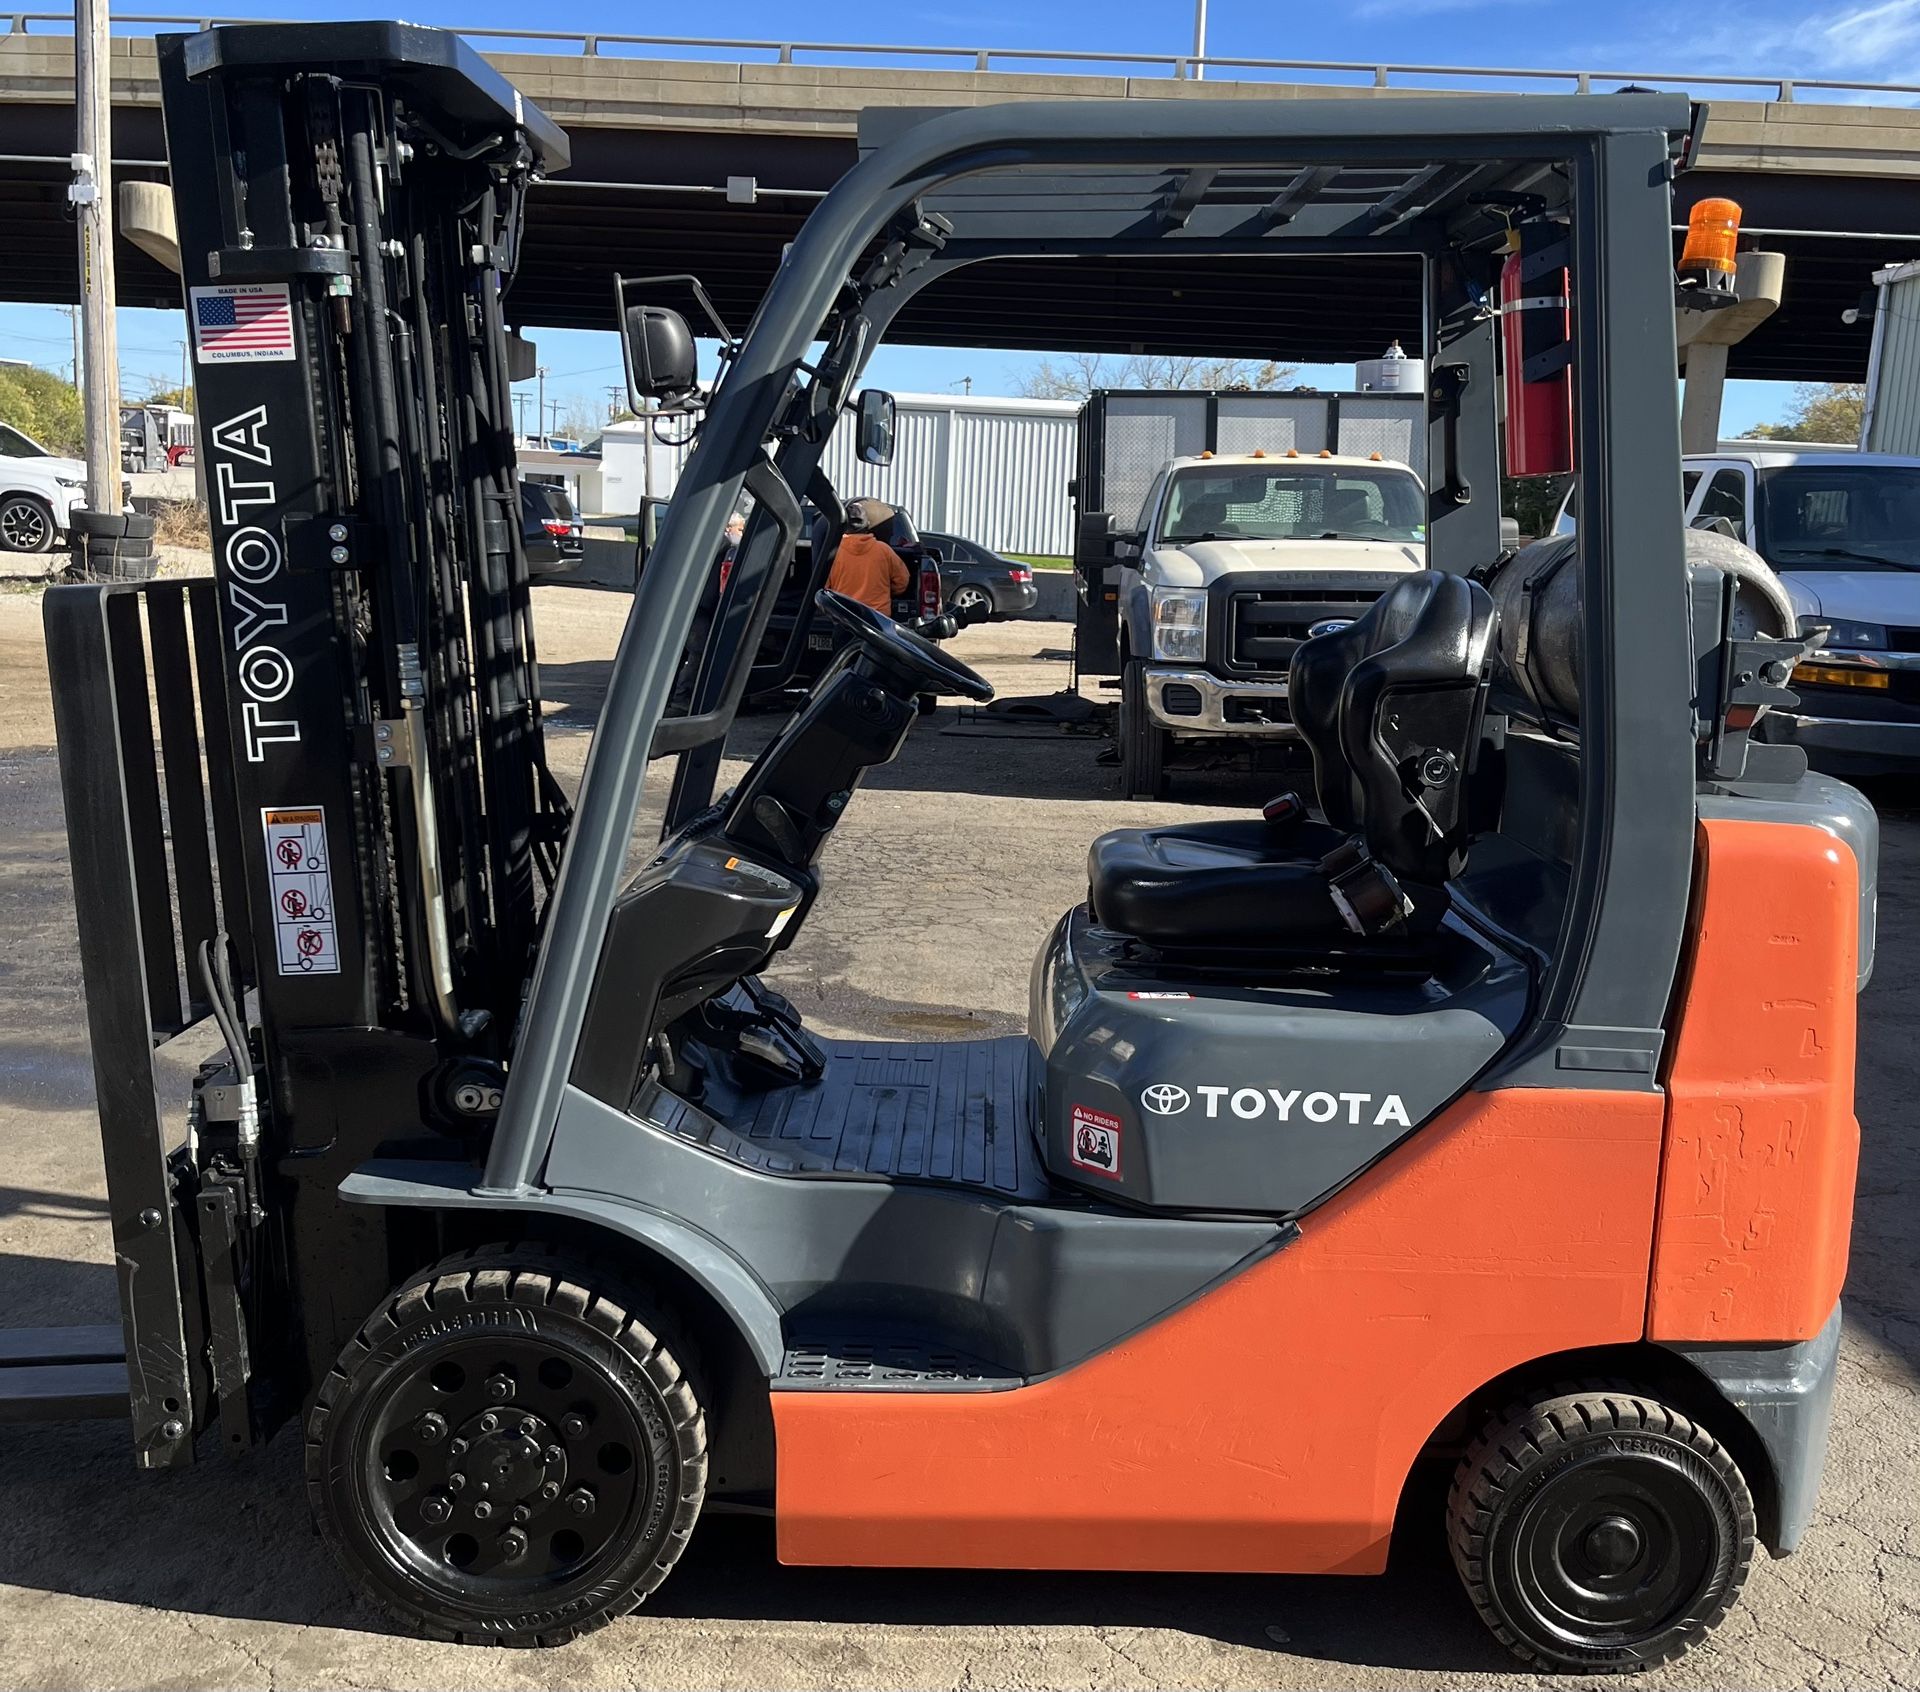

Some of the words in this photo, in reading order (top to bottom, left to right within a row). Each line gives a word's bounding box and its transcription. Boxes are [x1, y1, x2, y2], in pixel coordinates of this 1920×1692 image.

[213, 404, 301, 763] TOYOTA
[1257, 572, 1344, 582] SUPER
[280, 814, 319, 823] WARNING
[1197, 1085, 1412, 1128] TOYOTA
[1083, 1111, 1094, 1120] NO
[1094, 1115, 1119, 1129] RIDERS
